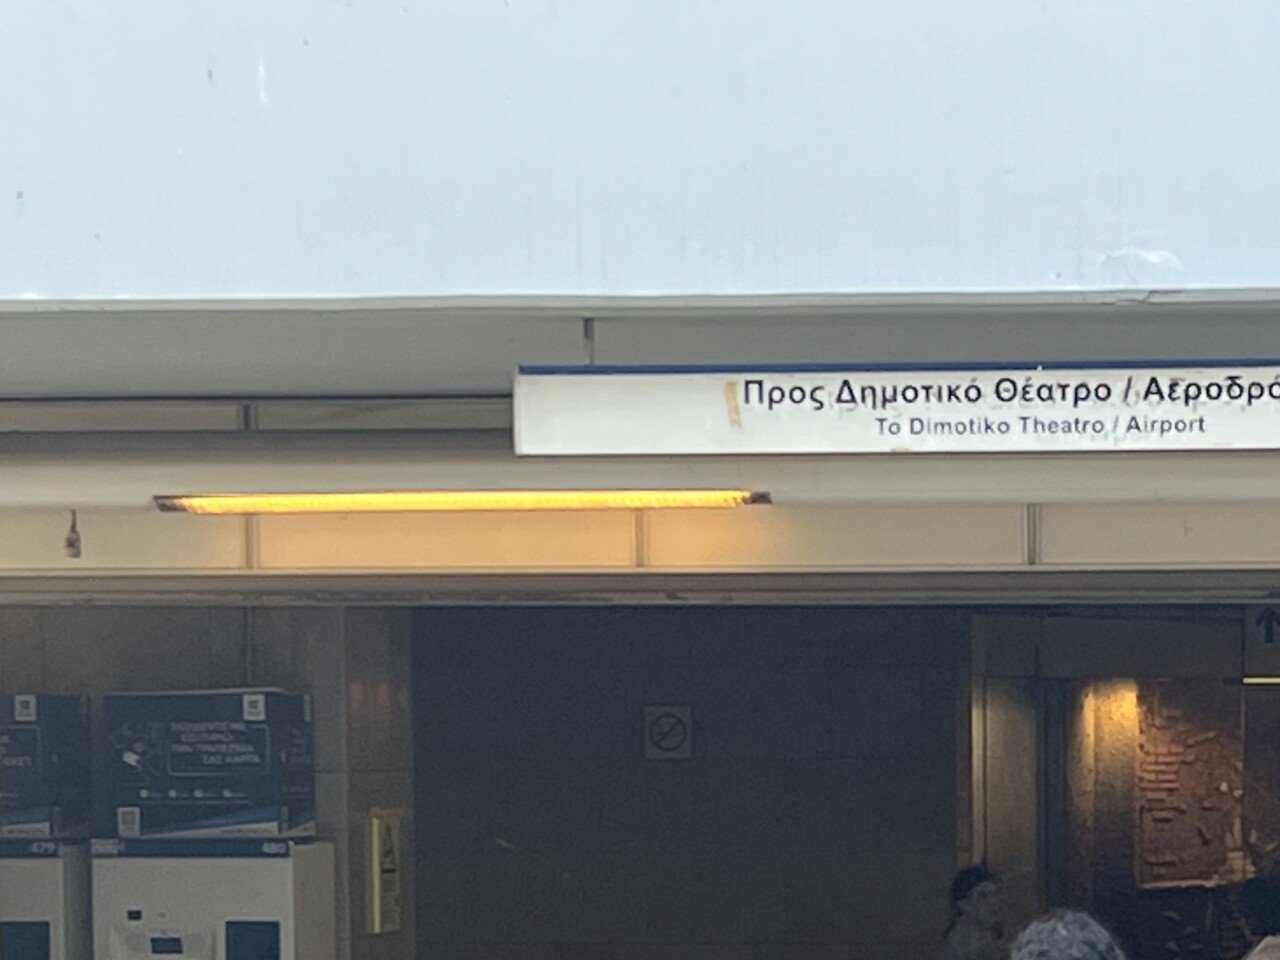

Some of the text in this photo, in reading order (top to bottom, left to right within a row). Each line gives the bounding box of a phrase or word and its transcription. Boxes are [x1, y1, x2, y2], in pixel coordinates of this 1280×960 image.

[744, 379, 825, 411] Προς
[835, 375, 982, 411] Δημοτικό
[995, 375, 1112, 408] Θέατρο
[875, 417, 901, 435] To
[909, 417, 1011, 436] Dimotiko
[1020, 415, 1105, 435] Theatro
[1125, 415, 1206, 437] Airport
